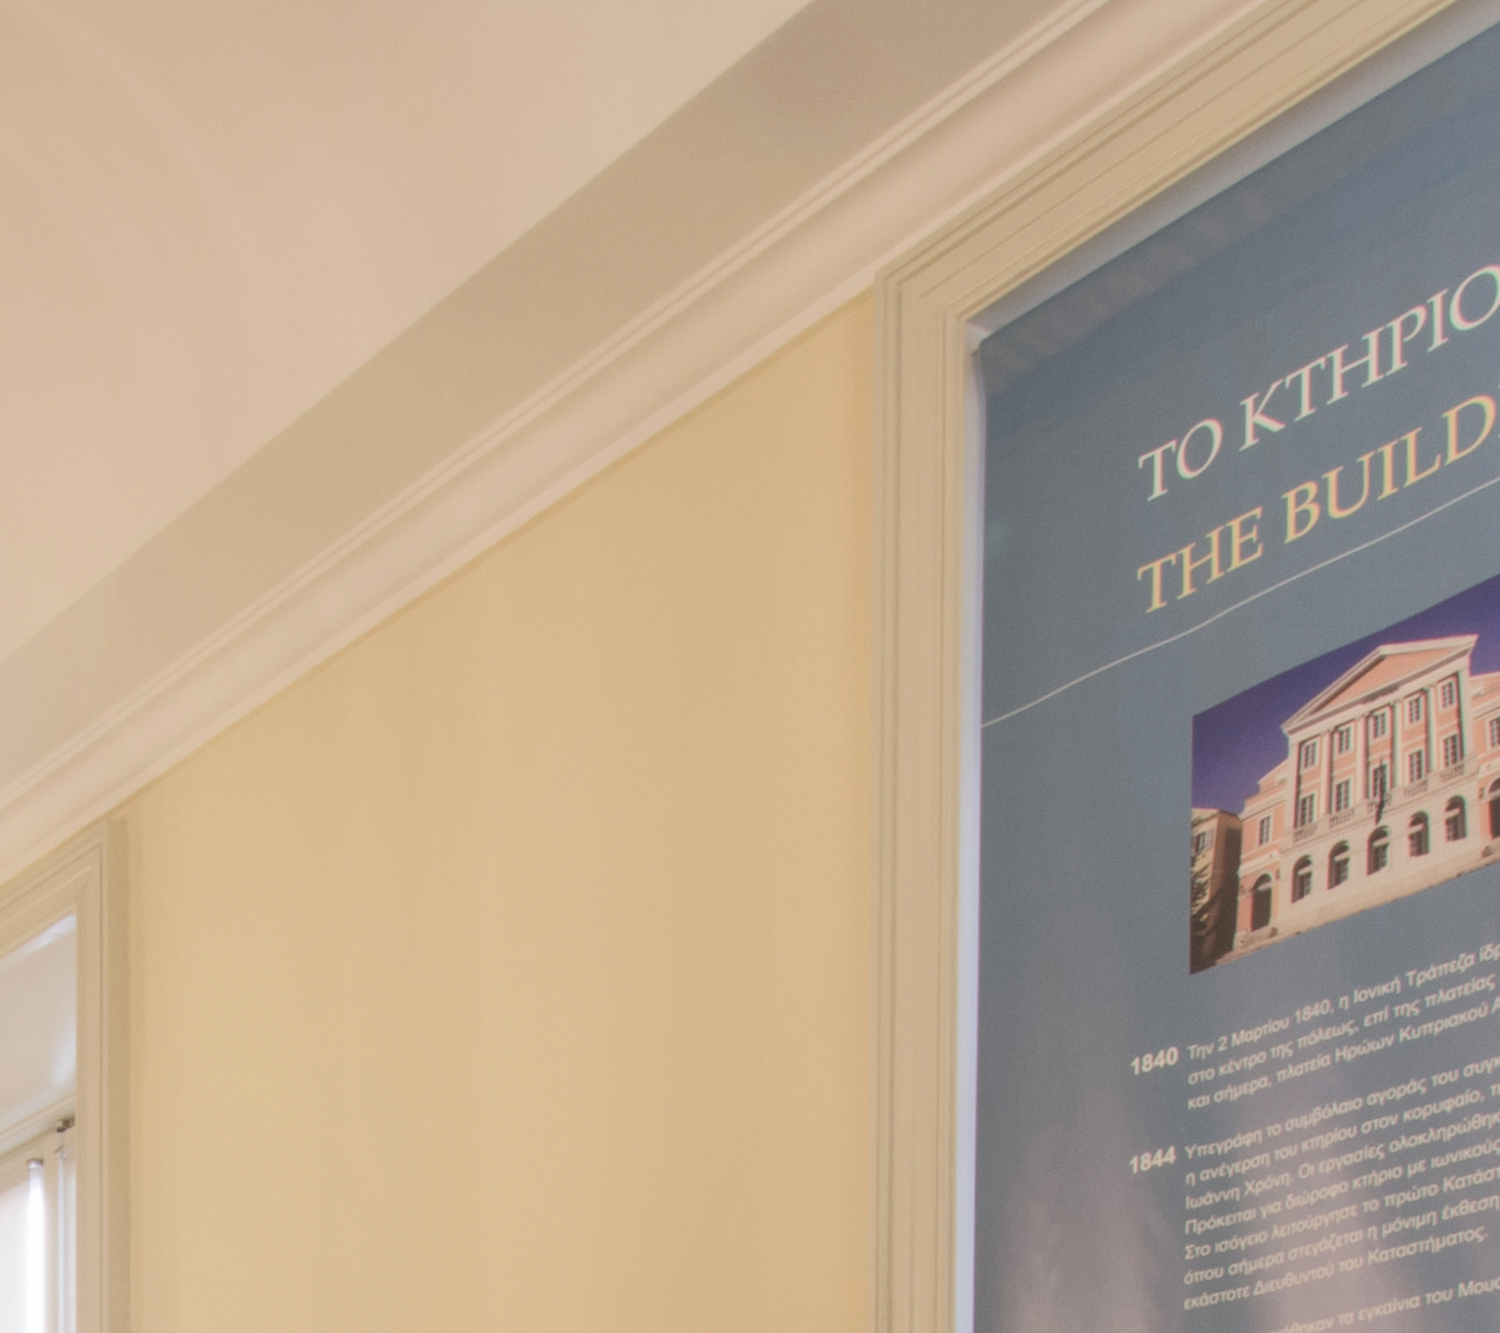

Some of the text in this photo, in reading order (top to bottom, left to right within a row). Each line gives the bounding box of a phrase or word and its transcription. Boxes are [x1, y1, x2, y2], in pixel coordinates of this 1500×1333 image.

[1138, 418, 1223, 501] ΤΟ
[1136, 506, 1263, 613] THE
[1129, 1044, 1178, 1078] 1840
[1185, 1040, 1215, 1060] Την
[1217, 1035, 1229, 1051] 2
[1231, 1016, 1291, 1046] Μαρτίου
[1293, 998, 1334, 1025] 1840,
[1338, 994, 1349, 1010] η
[1353, 973, 1401, 1005] Ιονική
[1403, 952, 1475, 988] Τράπεζα
[1187, 1067, 1215, 1085] στο
[1218, 1050, 1267, 1076] κέντρο
[1269, 1040, 1294, 1059] της
[1363, 1004, 1390, 1027] επί
[1391, 999, 1420, 1018] της
[1423, 974, 1496, 1008] πλατείας
[1127, 1143, 1177, 1177] 1844
[1183, 1127, 1263, 1161] Υπεγράφη
[1265, 1122, 1282, 1137] το
[1282, 1096, 1363, 1131] συμβόλαιο
[1365, 1076, 1427, 1106] αγοράς
[1429, 1068, 1459, 1087] του
[1336, 1310, 1355, 1326] τα
[1356, 1294, 1421, 1322] εγκαίνια
[1423, 1287, 1453, 1305] του
